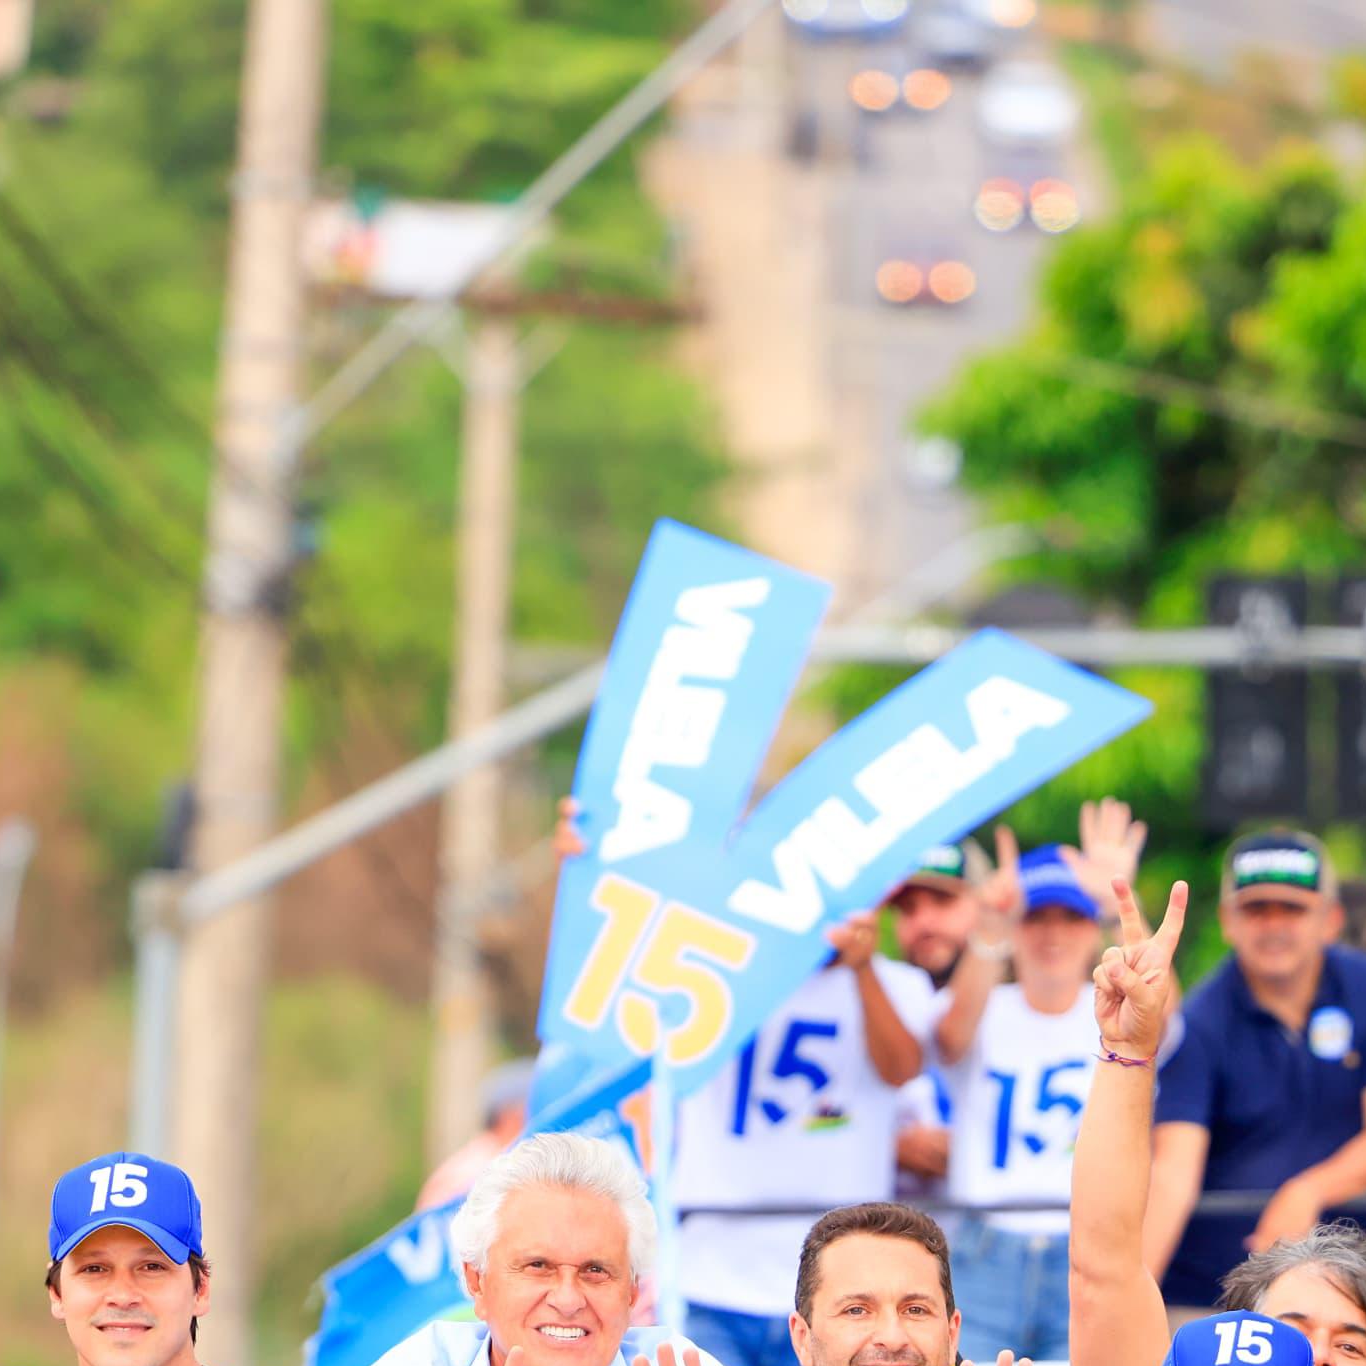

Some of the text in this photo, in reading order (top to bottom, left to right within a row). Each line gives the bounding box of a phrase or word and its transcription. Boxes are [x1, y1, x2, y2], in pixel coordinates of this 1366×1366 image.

[599, 577, 772, 862] VILELA
[728, 675, 1072, 933] VILELA
[563, 872, 757, 1066] 15
[731, 1020, 837, 1136] 15
[985, 1060, 1087, 1169] 15
[90, 1162, 148, 1215] 15
[1214, 1319, 1273, 1366] 15
